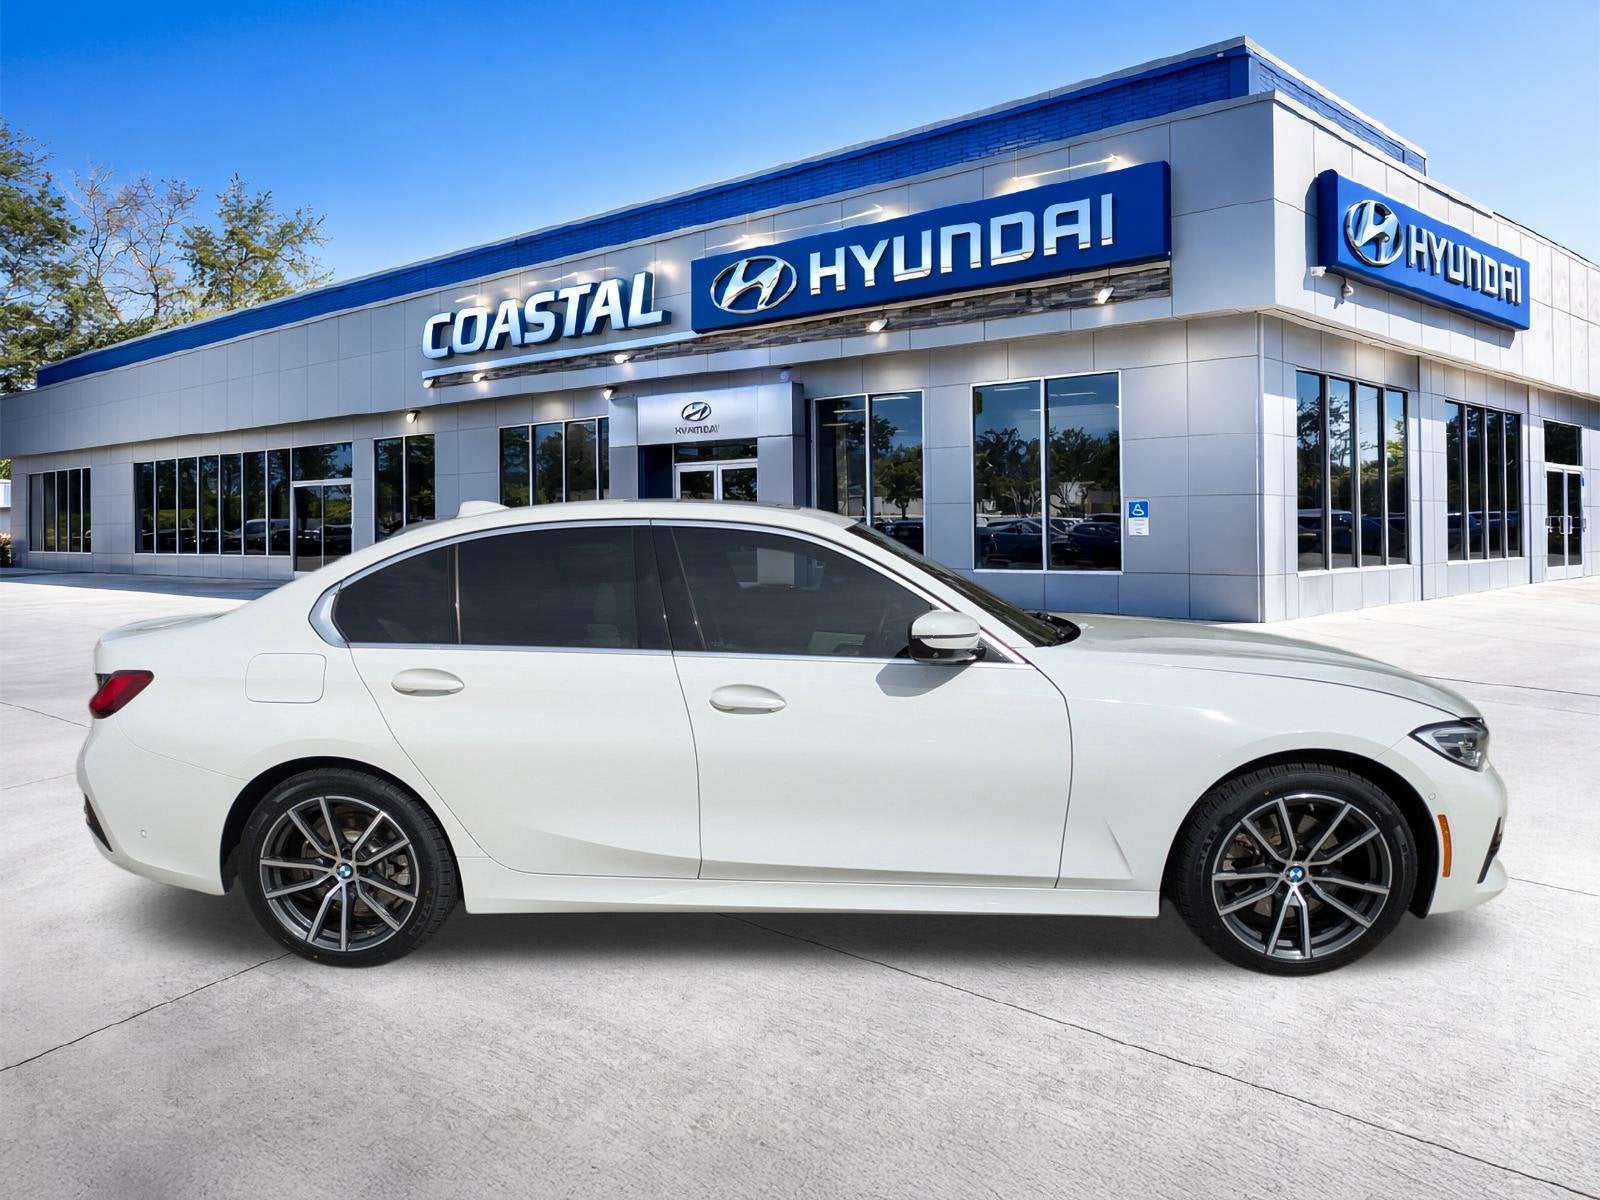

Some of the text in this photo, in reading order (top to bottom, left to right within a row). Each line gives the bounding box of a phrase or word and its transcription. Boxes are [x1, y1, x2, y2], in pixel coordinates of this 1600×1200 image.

[810, 193, 1113, 295] HYUNDAI
[1407, 224, 1521, 306] HYUNDAI
[422, 271, 671, 358] COASTAL
